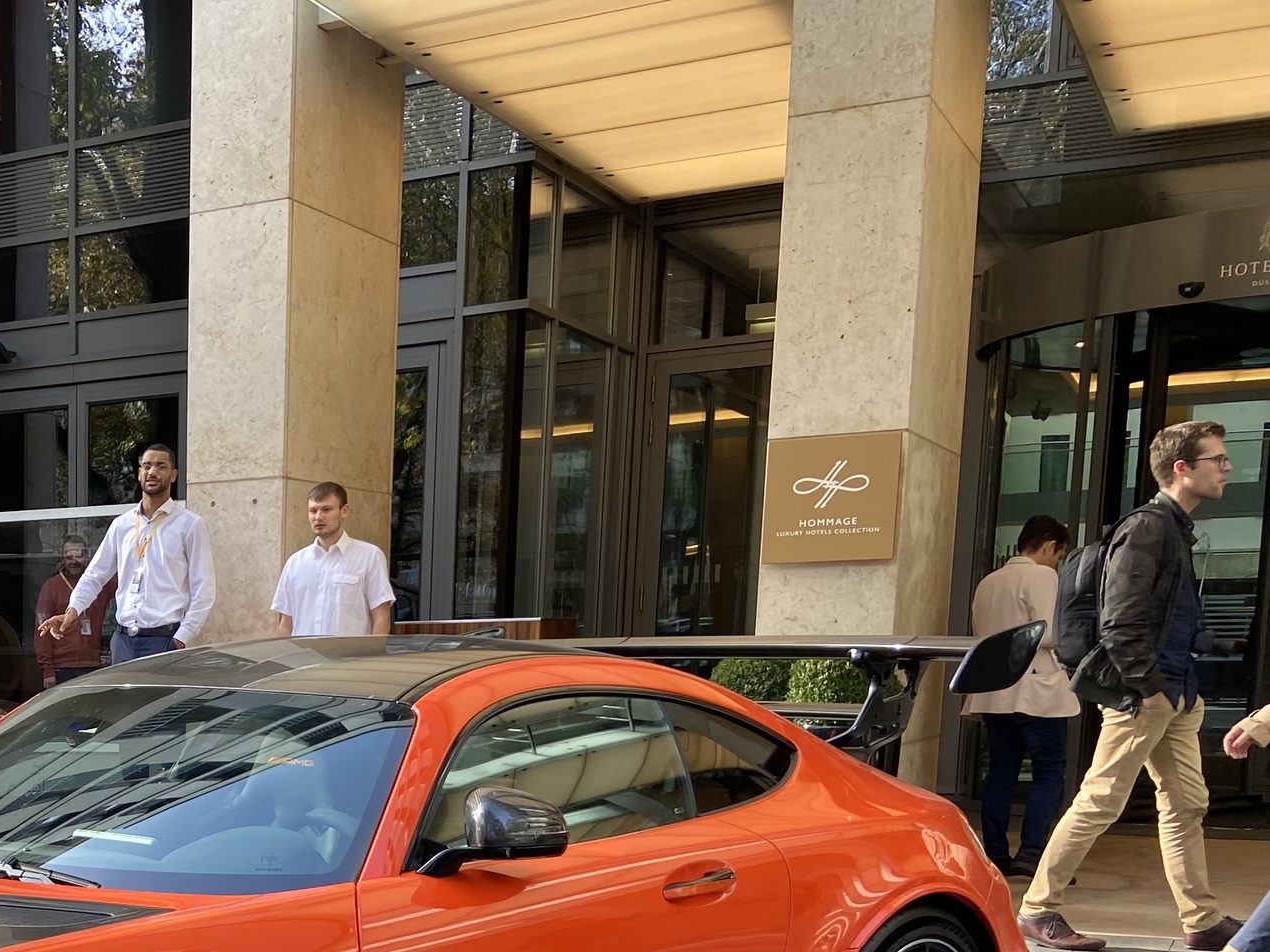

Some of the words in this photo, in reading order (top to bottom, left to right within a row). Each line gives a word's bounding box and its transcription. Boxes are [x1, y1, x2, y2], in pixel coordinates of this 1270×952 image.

[799, 517, 858, 528] HOMMAGE
[806, 528, 832, 536] HOTELS
[834, 527, 880, 535] COLLECTION
